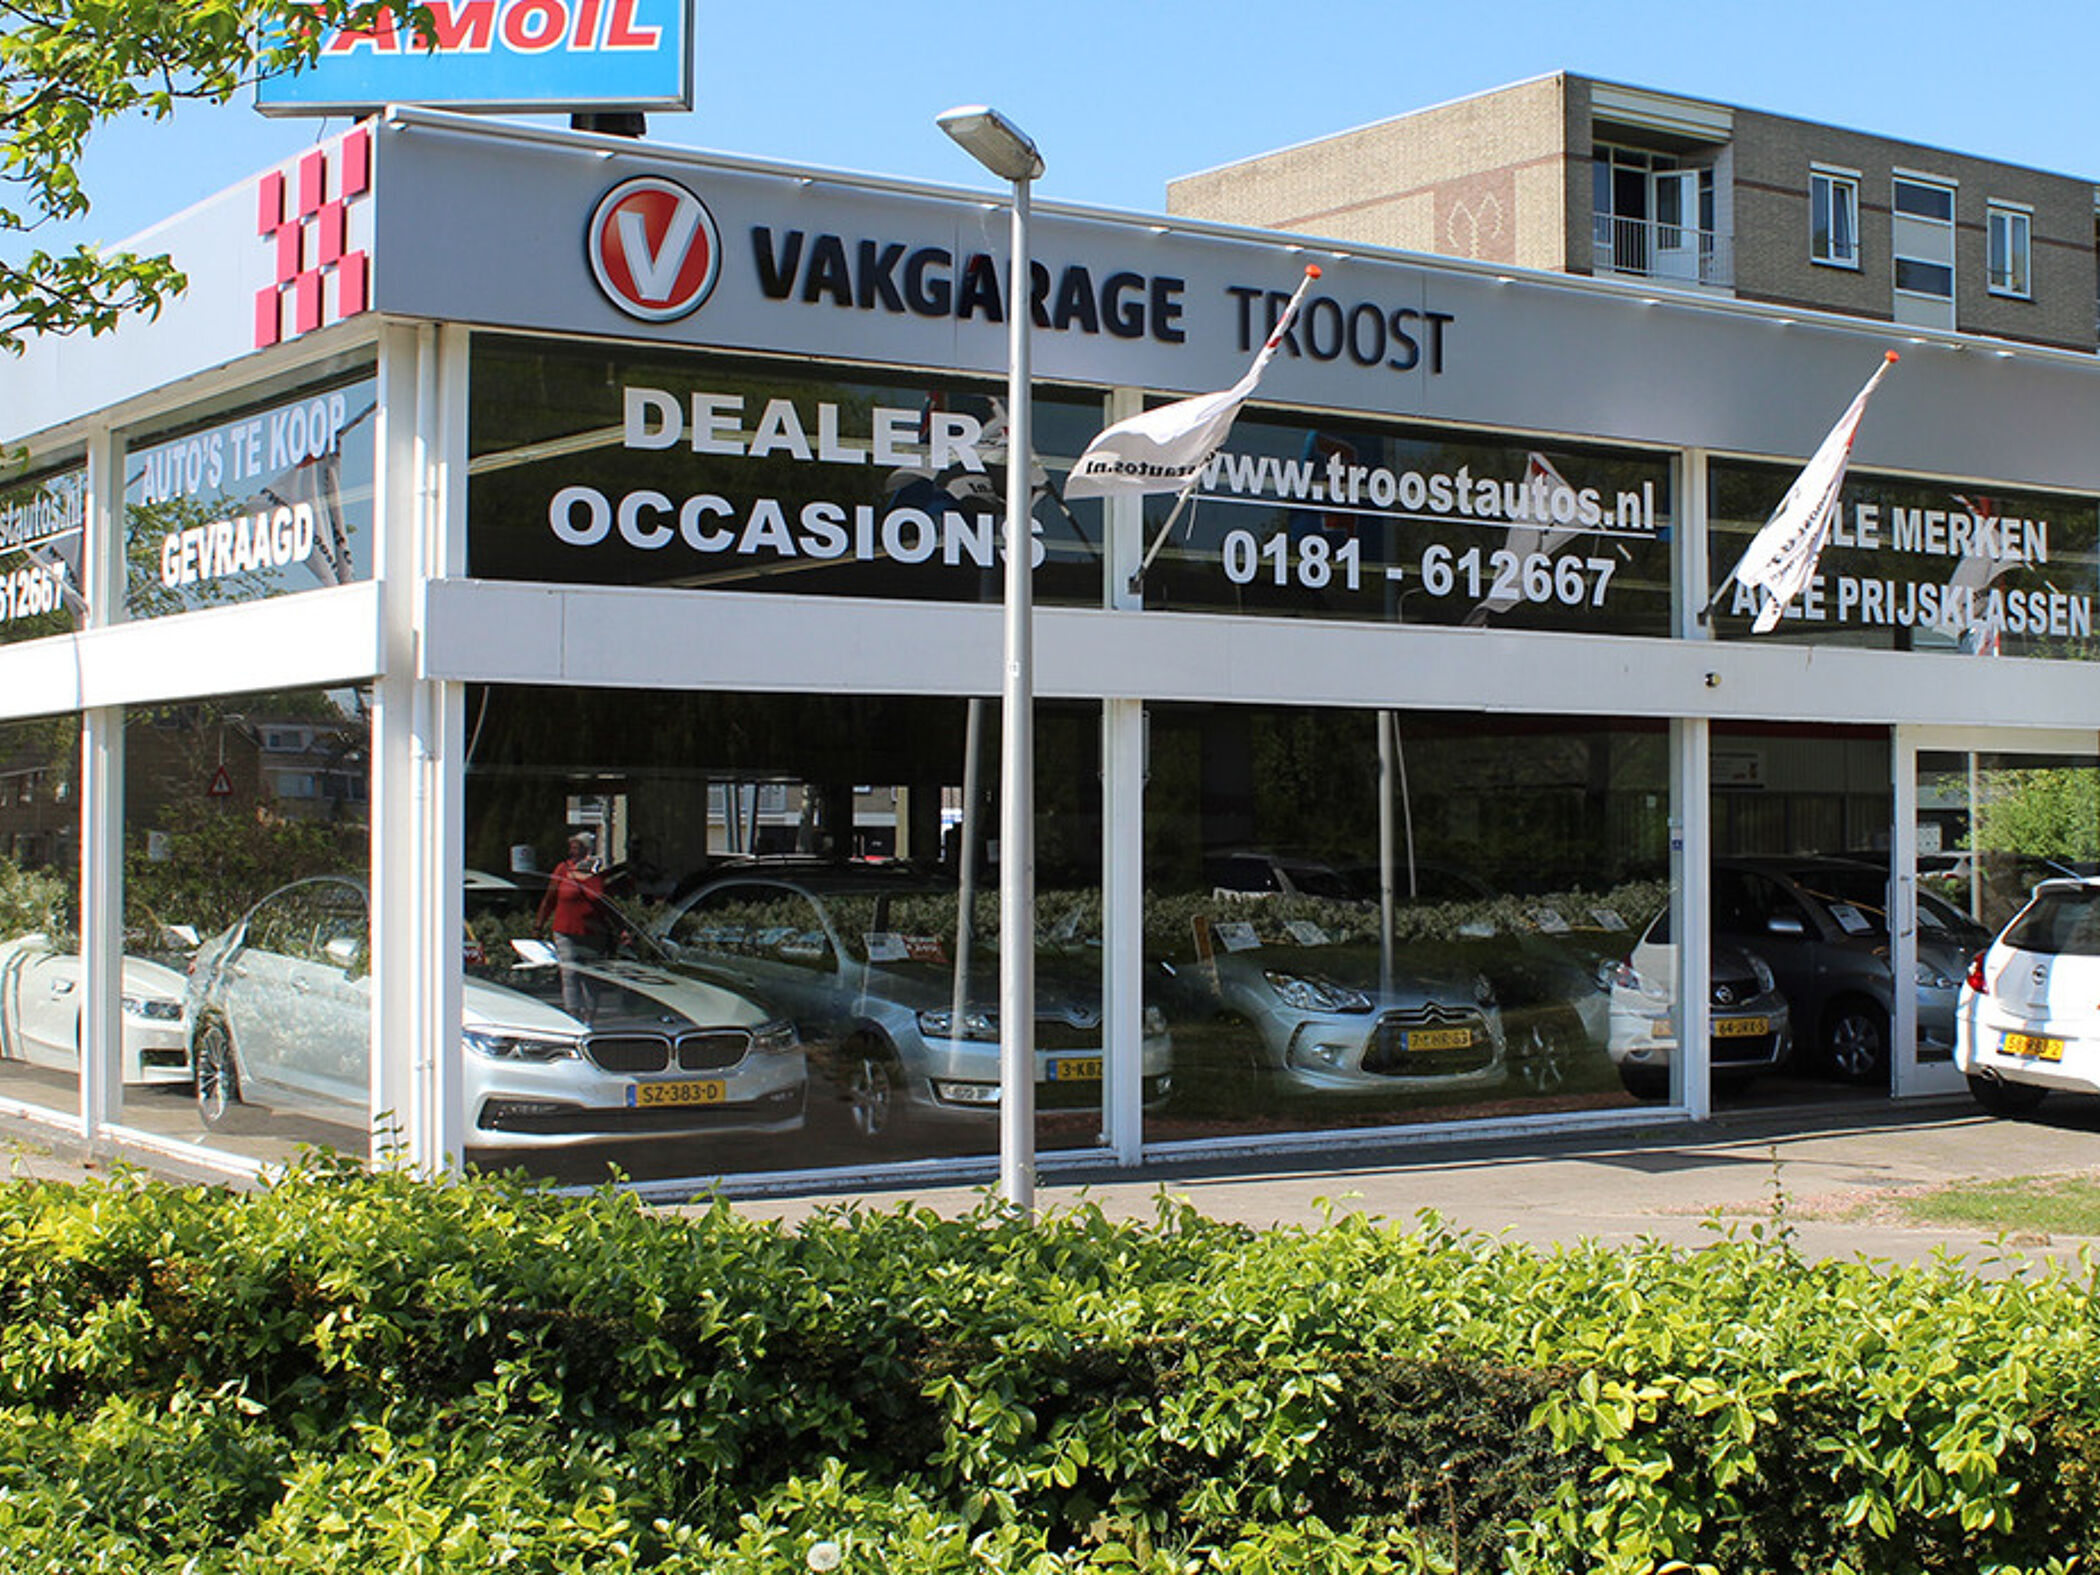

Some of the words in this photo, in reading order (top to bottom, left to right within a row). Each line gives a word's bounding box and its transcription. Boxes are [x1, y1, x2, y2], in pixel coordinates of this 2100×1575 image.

[266, 0, 662, 54] AMOIL
[751, 226, 1186, 344] VAKGARAGE
[1226, 285, 1455, 374] TROOST
[141, 432, 223, 506] AUTO'S
[230, 420, 262, 482] TE
[269, 394, 346, 471] KOOP
[623, 386, 987, 473] DEALER
[161, 502, 314, 588] GEVRAAGD
[1223, 529, 1361, 590] 0181
[1421, 544, 1617, 606] 612667
[1892, 507, 2048, 564] MERKEN
[1838, 577, 2091, 637] PRIJSKLASSEN
[643, 1084, 718, 1103] SZ-383-D
